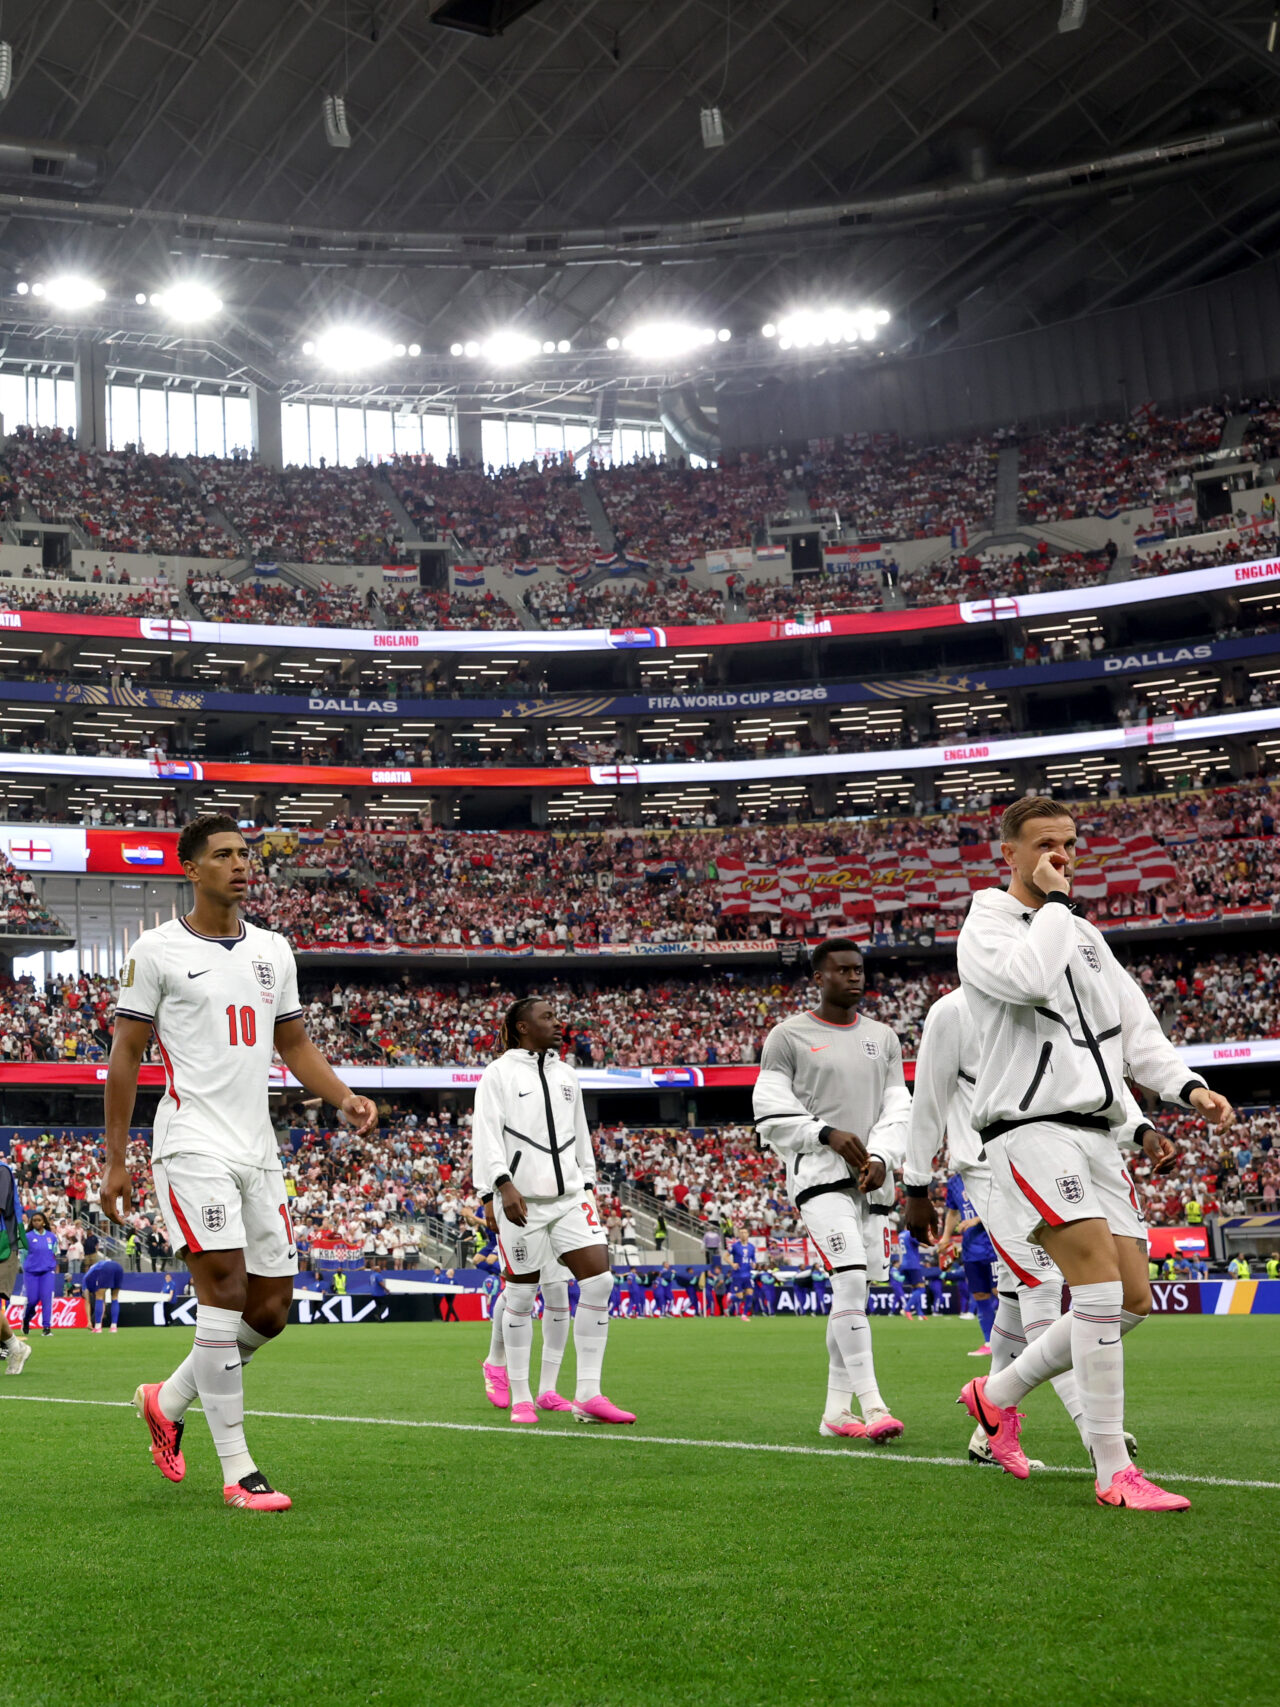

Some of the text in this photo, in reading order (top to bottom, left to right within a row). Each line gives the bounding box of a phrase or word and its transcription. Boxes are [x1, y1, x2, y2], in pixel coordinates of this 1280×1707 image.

[373, 634, 419, 648] ENGLAND
[1104, 645, 1212, 672] DALLAS
[648, 687, 827, 709] FIFA WORLD CUP 2026
[309, 699, 397, 713] DALLAS
[943, 746, 989, 761] ENGLAND
[372, 770, 411, 784] CROATIA
[226, 1005, 257, 1047] 10
[1214, 1048, 1251, 1059] ENGLAND
